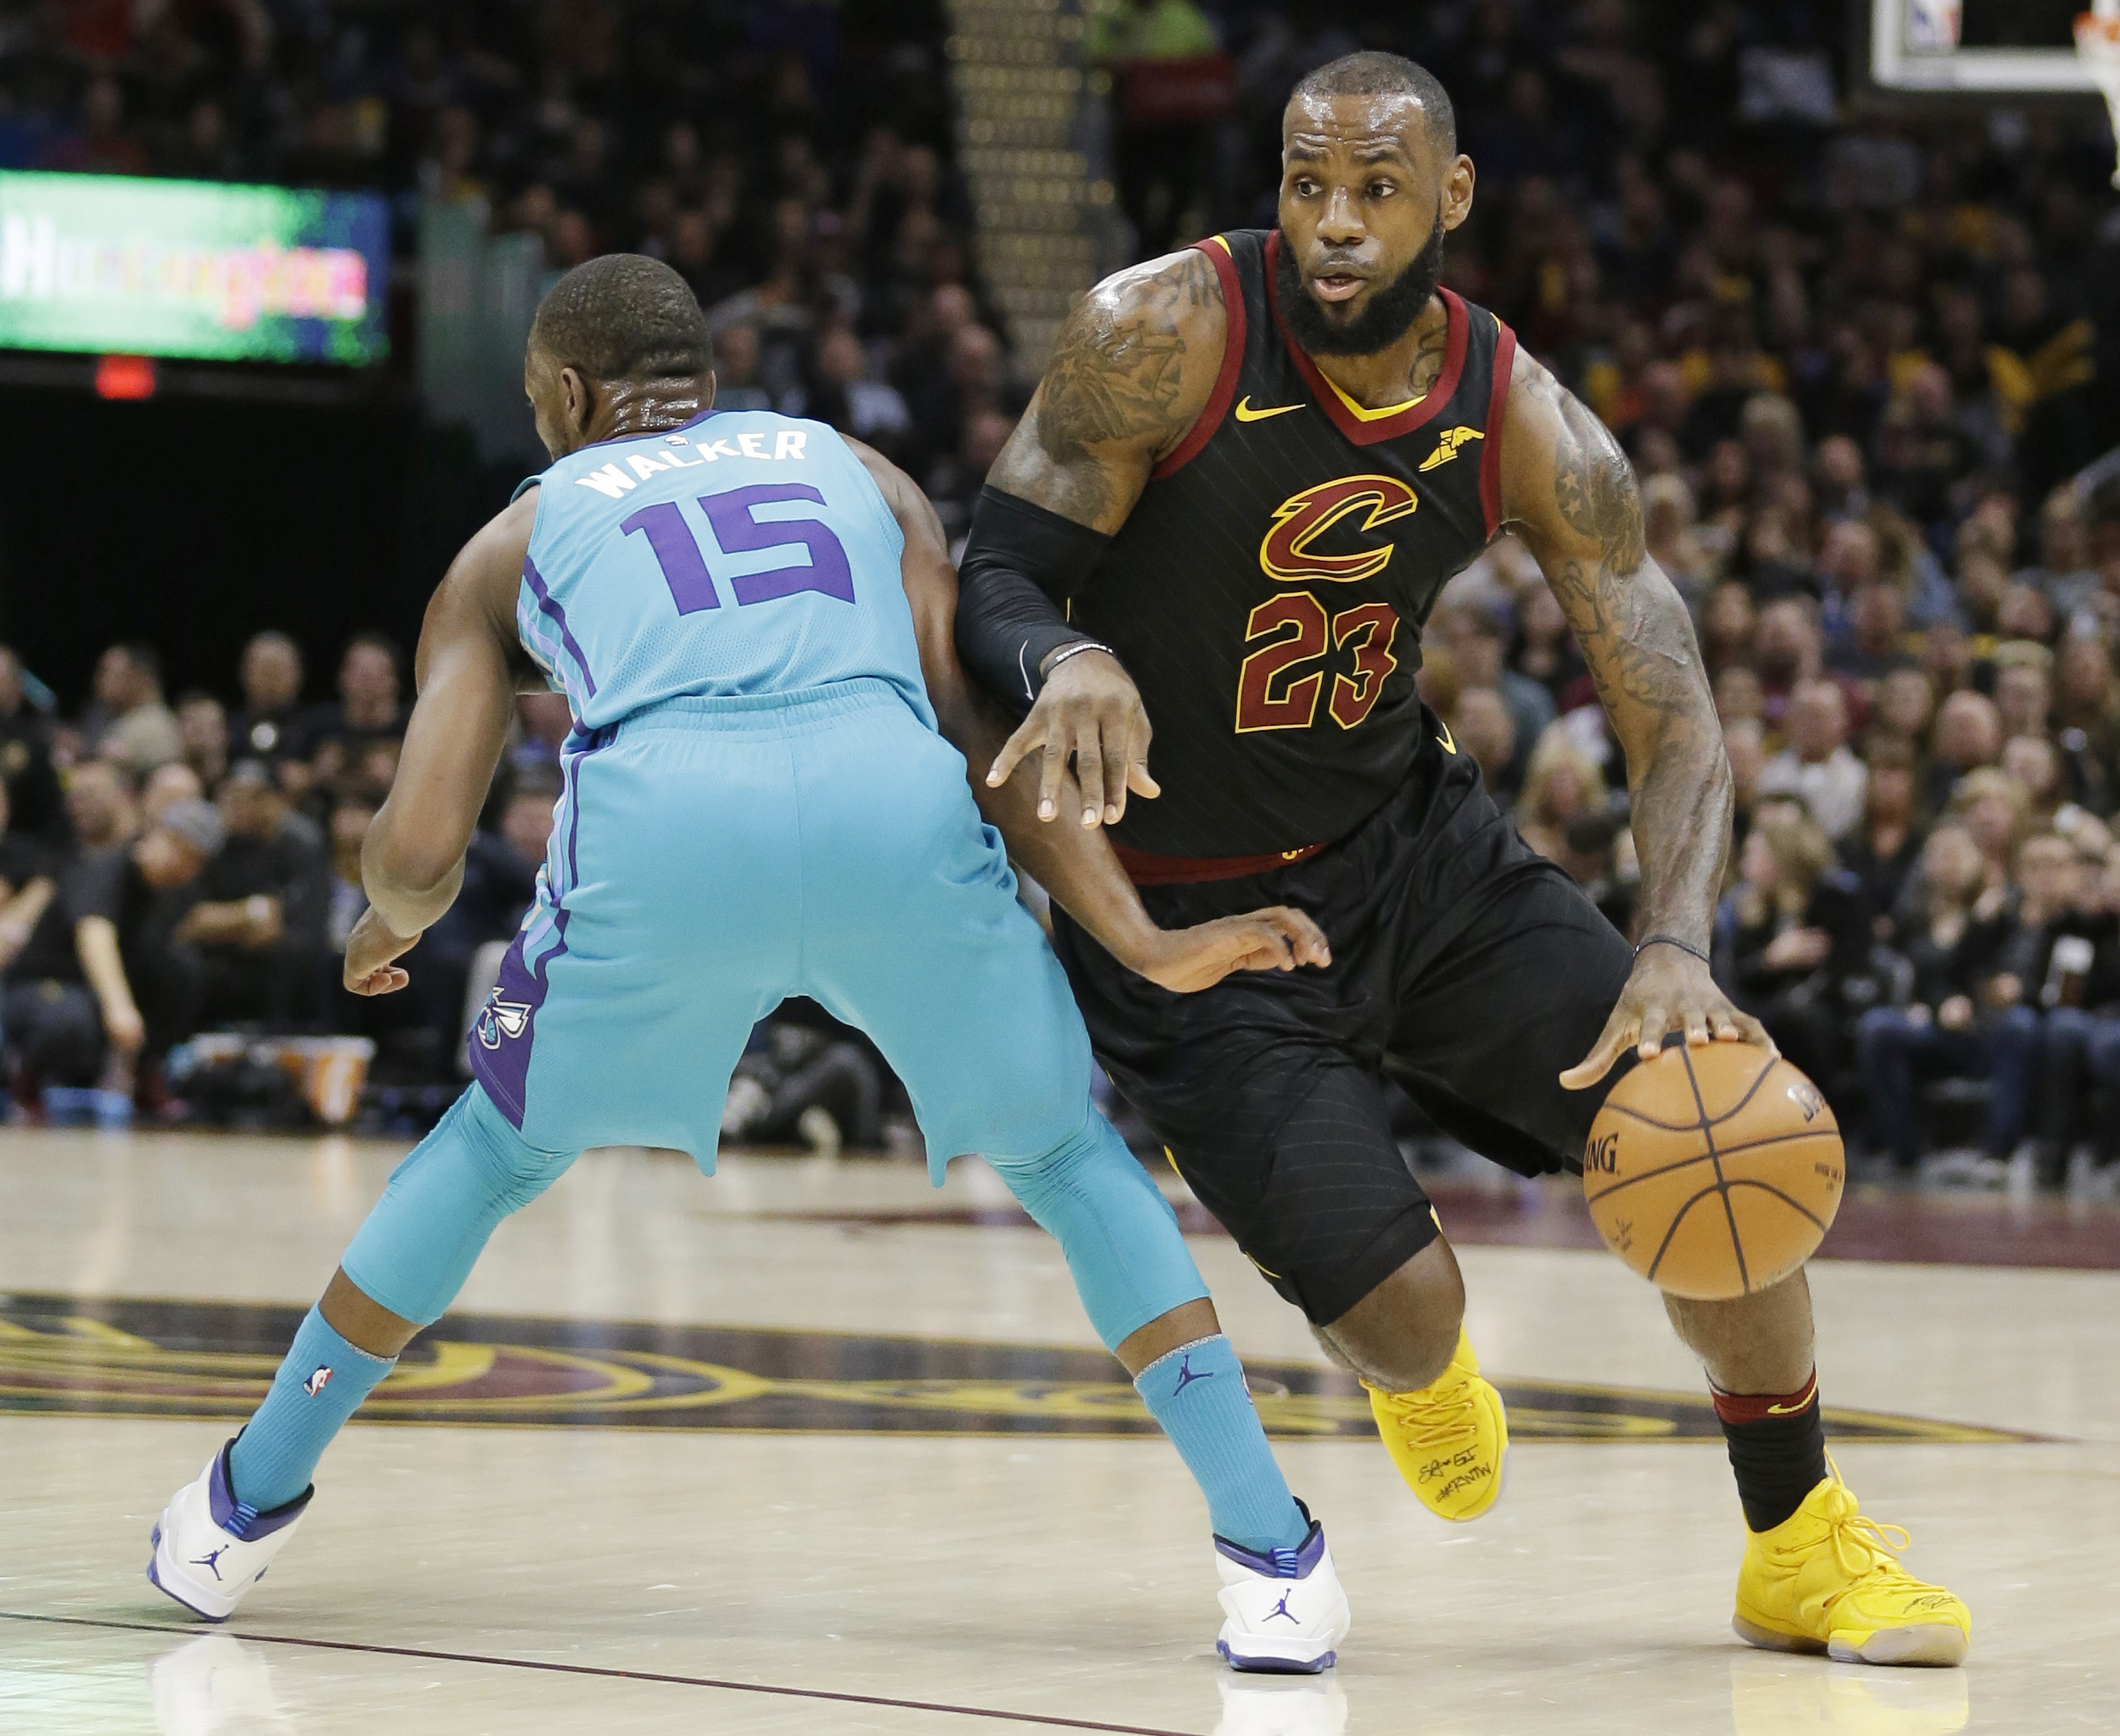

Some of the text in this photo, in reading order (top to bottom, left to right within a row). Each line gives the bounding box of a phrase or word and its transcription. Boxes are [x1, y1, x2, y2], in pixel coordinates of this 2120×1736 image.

[573, 431, 807, 499] WALKER
[619, 482, 856, 616] 15
[1235, 590, 1399, 734] 23
